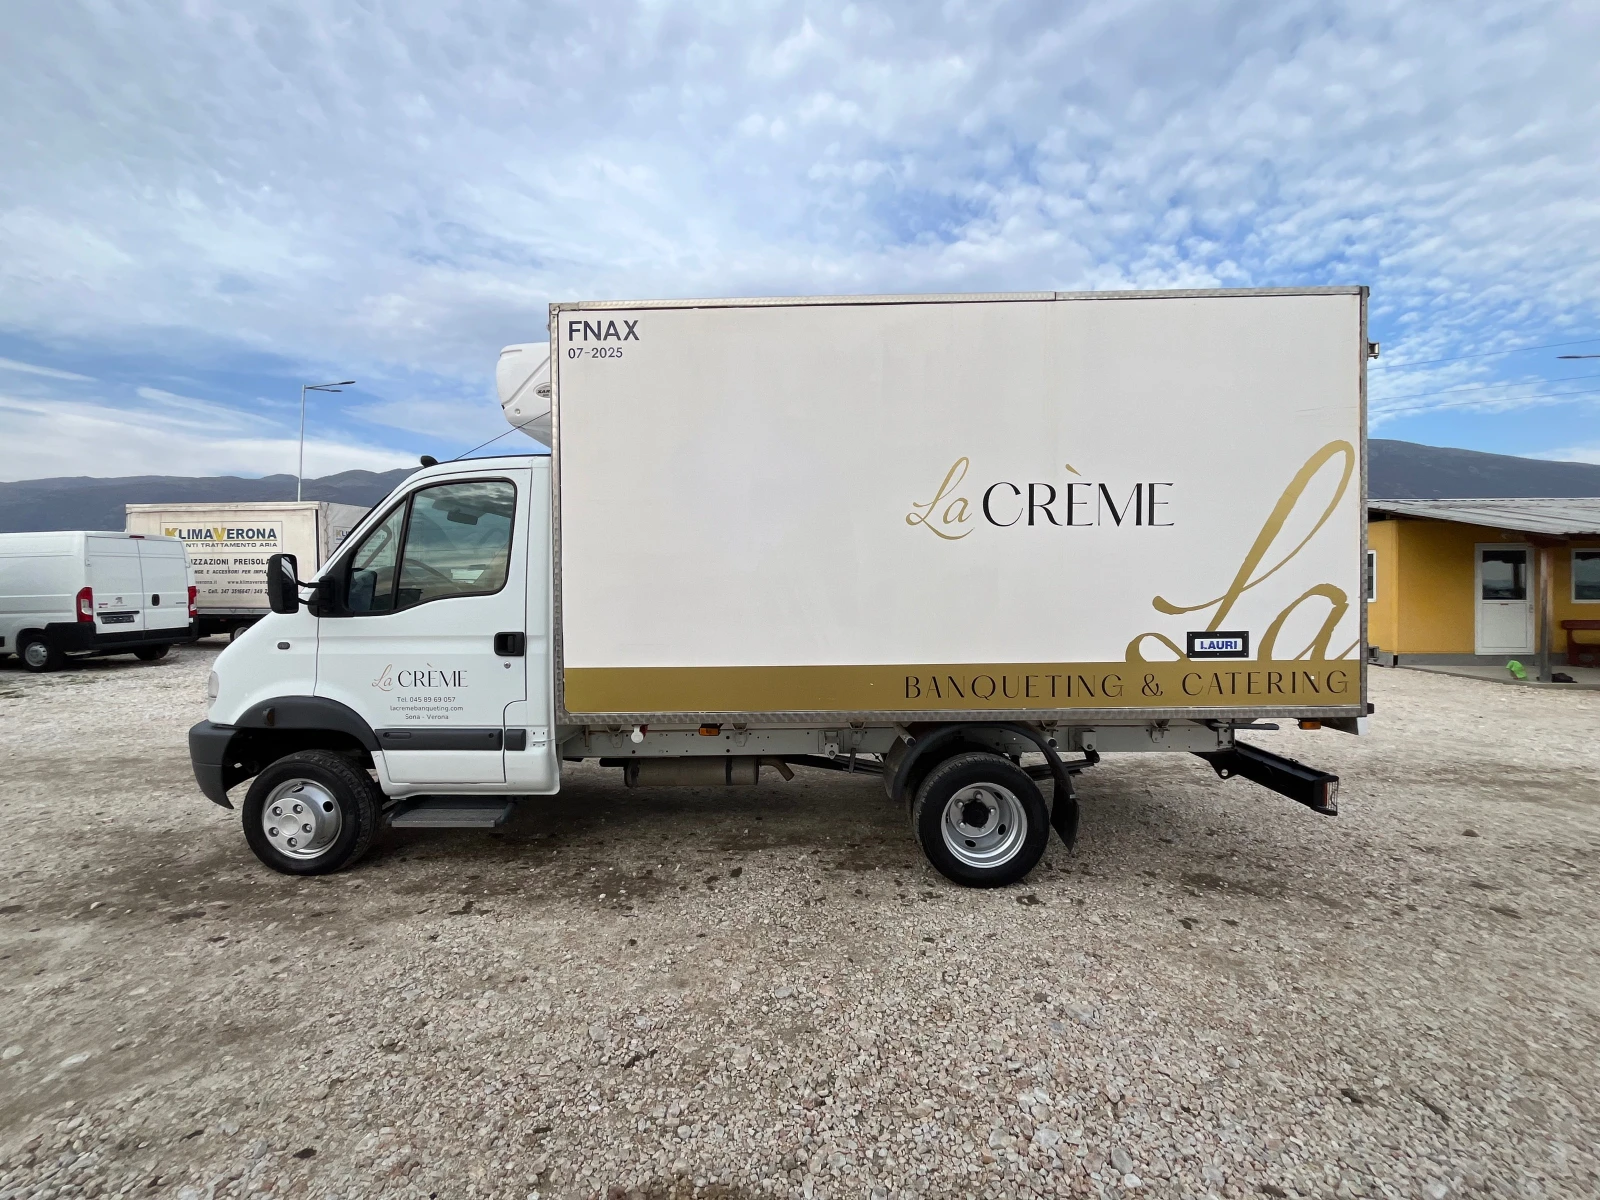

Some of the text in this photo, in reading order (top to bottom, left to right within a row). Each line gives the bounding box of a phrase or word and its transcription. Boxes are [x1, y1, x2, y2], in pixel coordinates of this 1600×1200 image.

[568, 320, 640, 341] FNAX
[568, 347, 623, 359] 07-2025
[905, 456, 1175, 541] La CRÈME
[164, 528, 277, 542] KLIMAVERONA
[1200, 641, 1238, 650] LAURI
[371, 663, 468, 691] La CRÈME
[904, 669, 1350, 700] BANQUETING & CATERING
